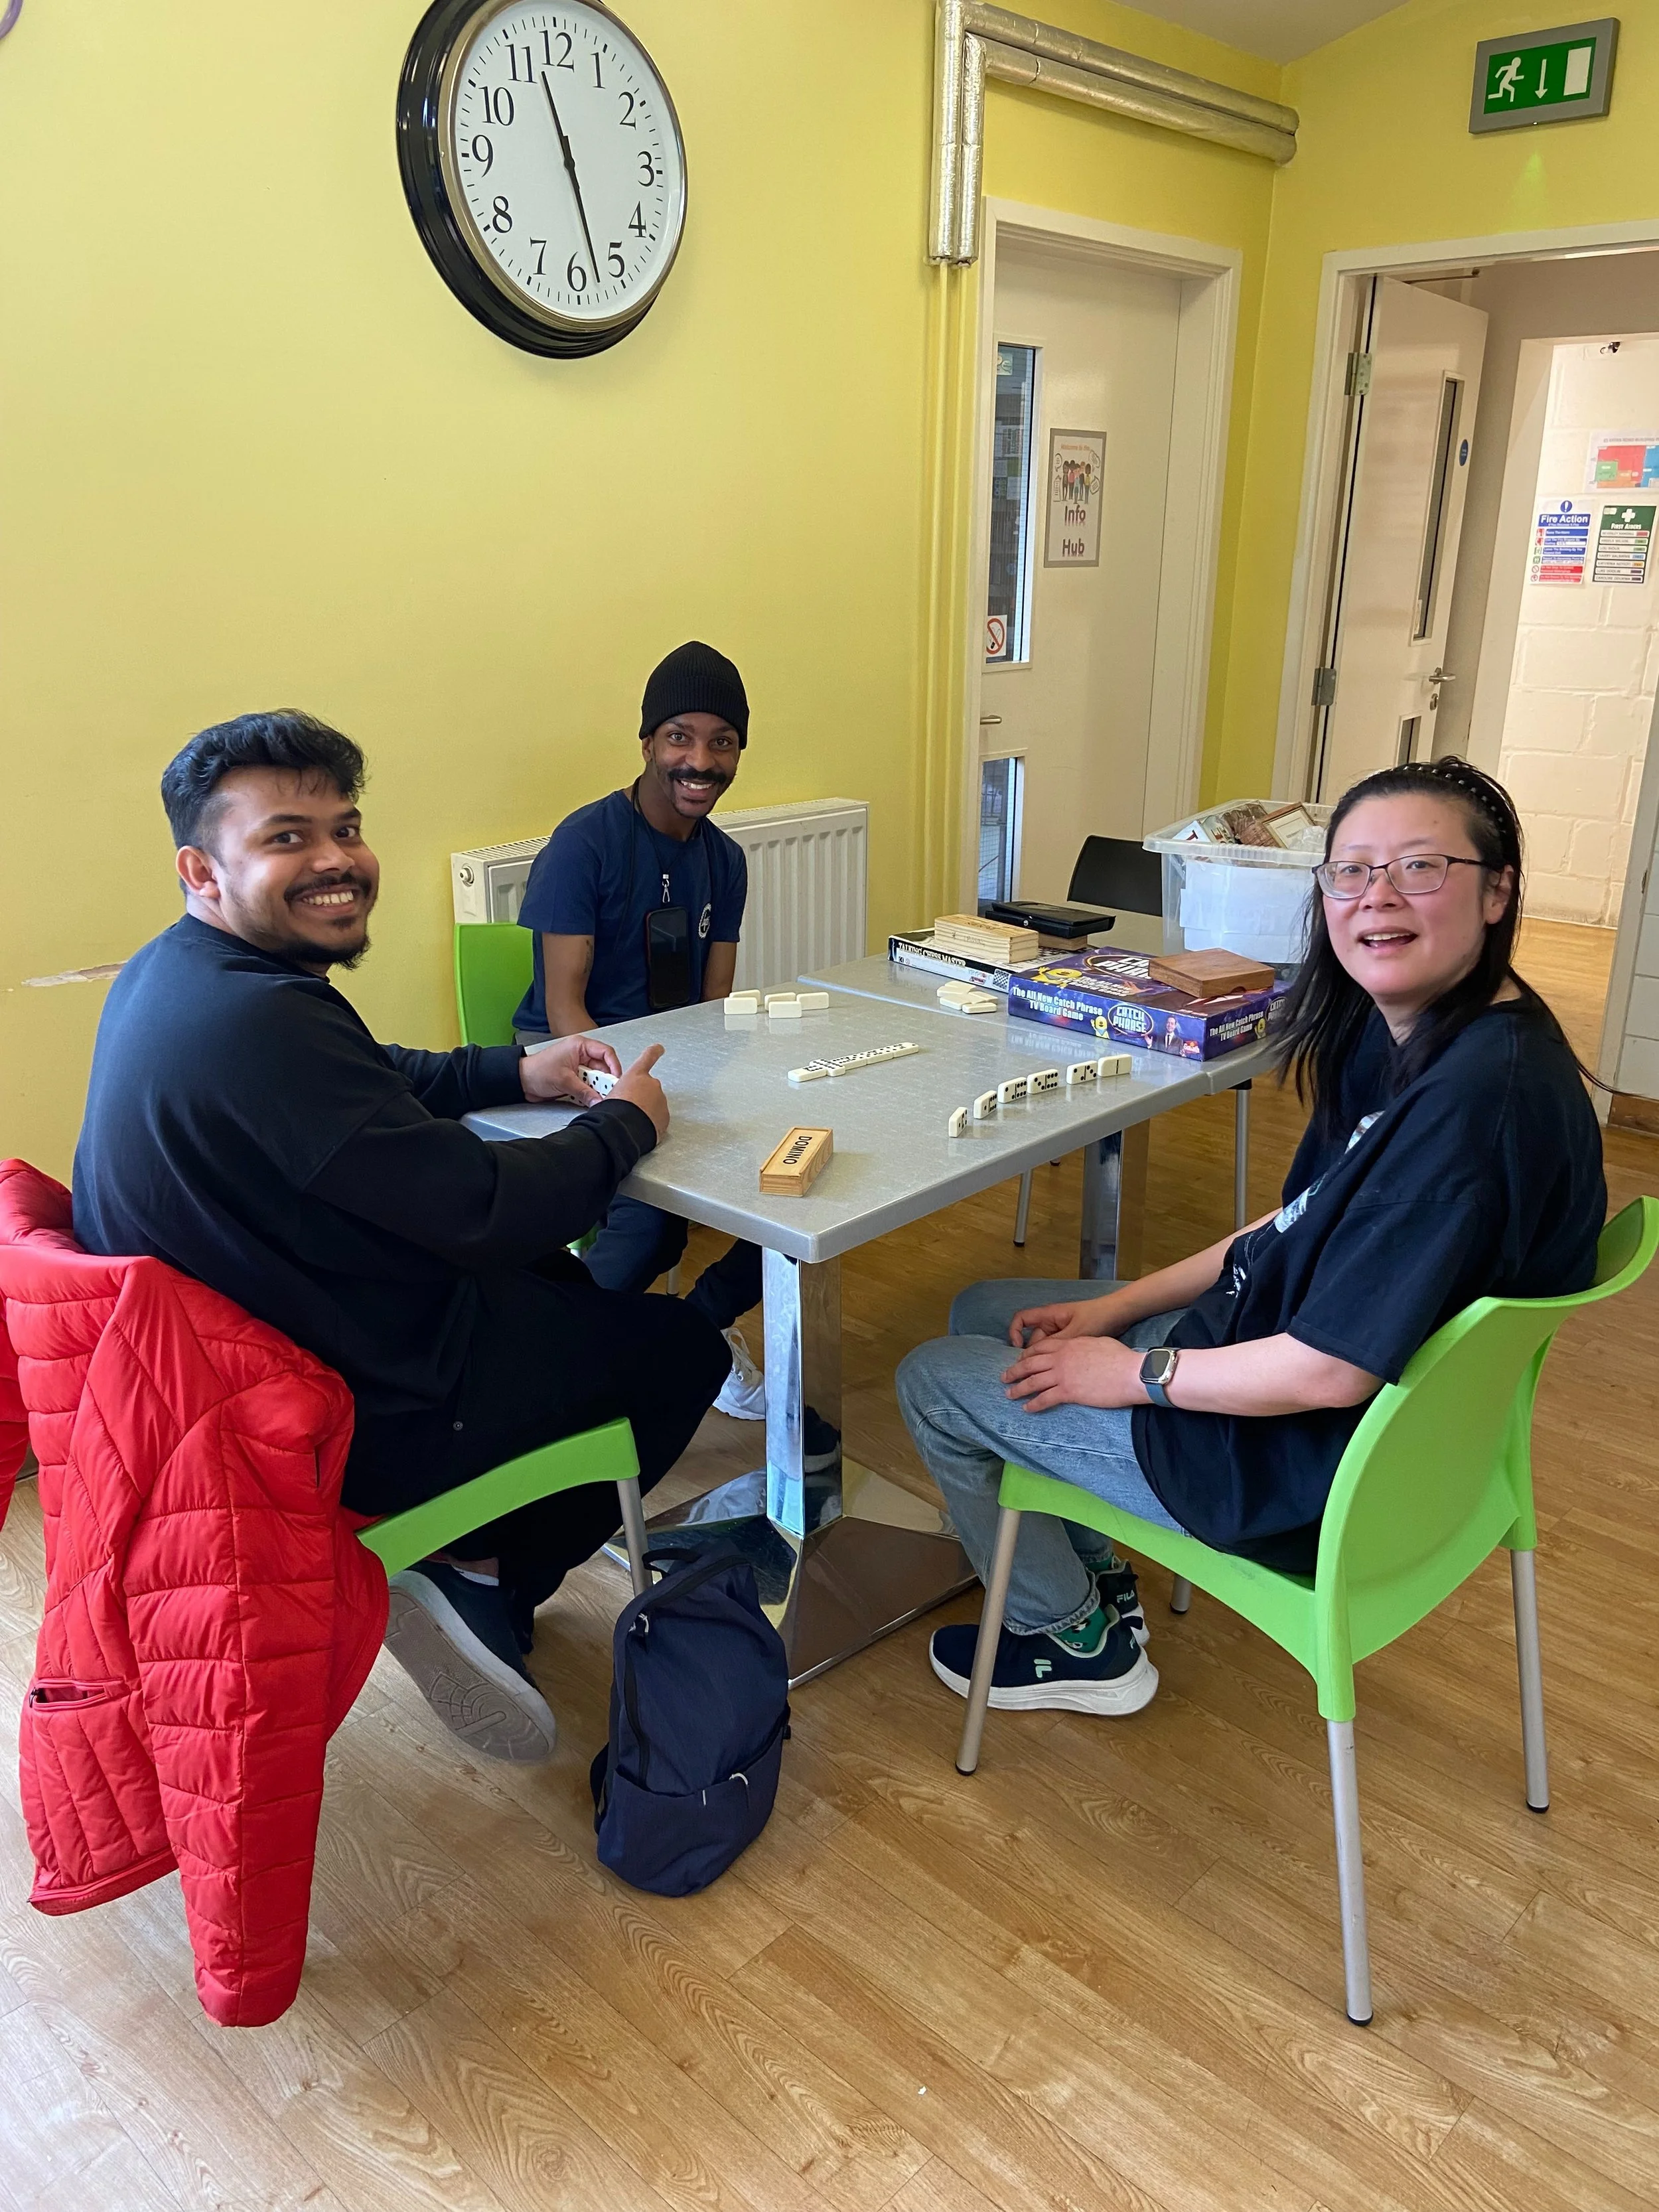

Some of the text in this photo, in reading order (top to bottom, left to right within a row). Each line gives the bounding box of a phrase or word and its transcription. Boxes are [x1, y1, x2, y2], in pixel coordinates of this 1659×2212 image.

[504, 43, 538, 84] 11
[540, 30, 575, 73] 12
[591, 52, 606, 89] 1
[478, 86, 515, 126] 10
[618, 91, 636, 130] 2
[472, 134, 494, 178] 9
[637, 151, 655, 187] 3
[492, 195, 513, 234] 8
[628, 200, 646, 238] 4
[530, 236, 547, 275] 7
[567, 251, 587, 292] 6
[608, 240, 625, 278] 5
[1064, 504, 1086, 522] Info
[1540, 514, 1588, 524] Fire Action
[1062, 538, 1086, 555] Hub
[1013, 986, 1103, 1016] The All New Catch Phrase
[1029, 999, 1084, 1021] TV Board Game
[1116, 1006, 1145, 1023] CATCH
[1112, 1015, 1147, 1033] PHRASE
[1210, 1027, 1219, 1037] The
[1225, 1021, 1236, 1032] New
[1235, 1016, 1249, 1027] Catch
[1248, 1011, 1263, 1023] Phrase
[1220, 1023, 1253, 1041] TV Board Game
[782, 1136, 813, 1165] DOMINO
[1116, 1589, 1135, 1604] FILA
